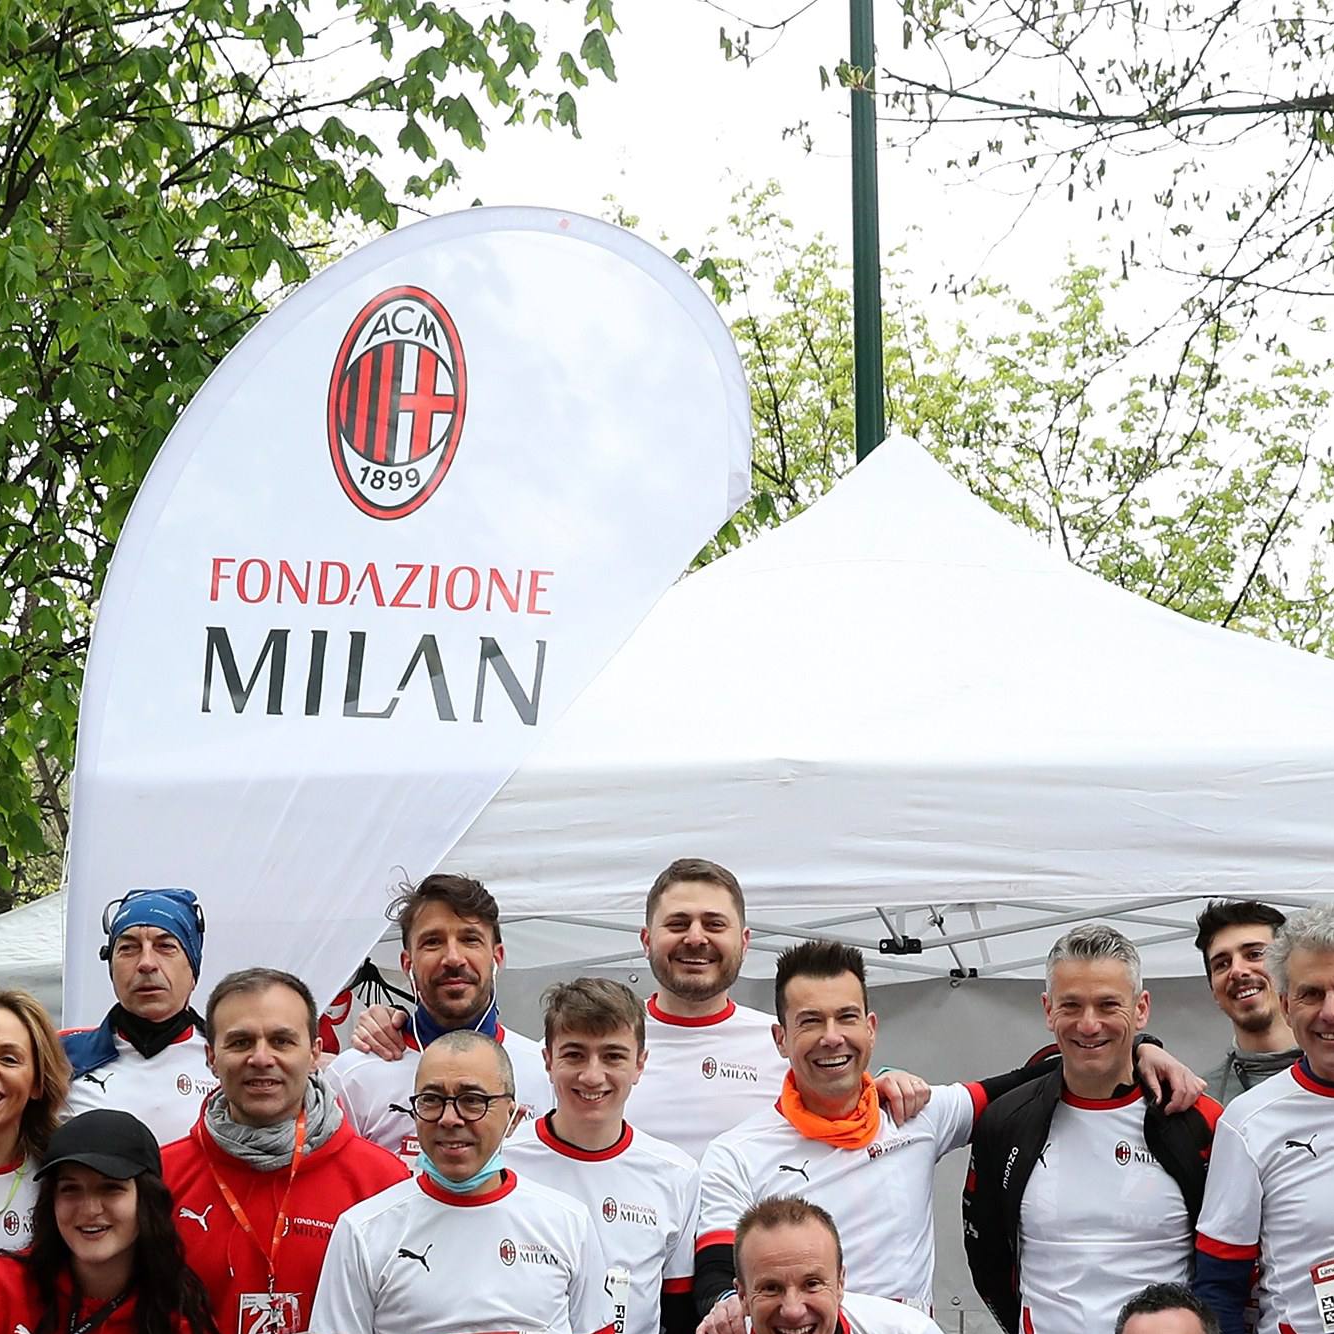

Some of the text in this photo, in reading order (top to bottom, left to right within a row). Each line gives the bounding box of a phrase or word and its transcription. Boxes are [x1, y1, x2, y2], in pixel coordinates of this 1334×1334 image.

[365, 305, 440, 348] ACM
[358, 466, 422, 492] 1899
[208, 557, 555, 616] FONDAZIONE
[200, 626, 547, 727] MILAN
[720, 1069, 758, 1082] MILAN
[1003, 1146, 1019, 1189] monza
[620, 1211, 658, 1226] MILAN
[519, 1250, 559, 1265] MILAN
